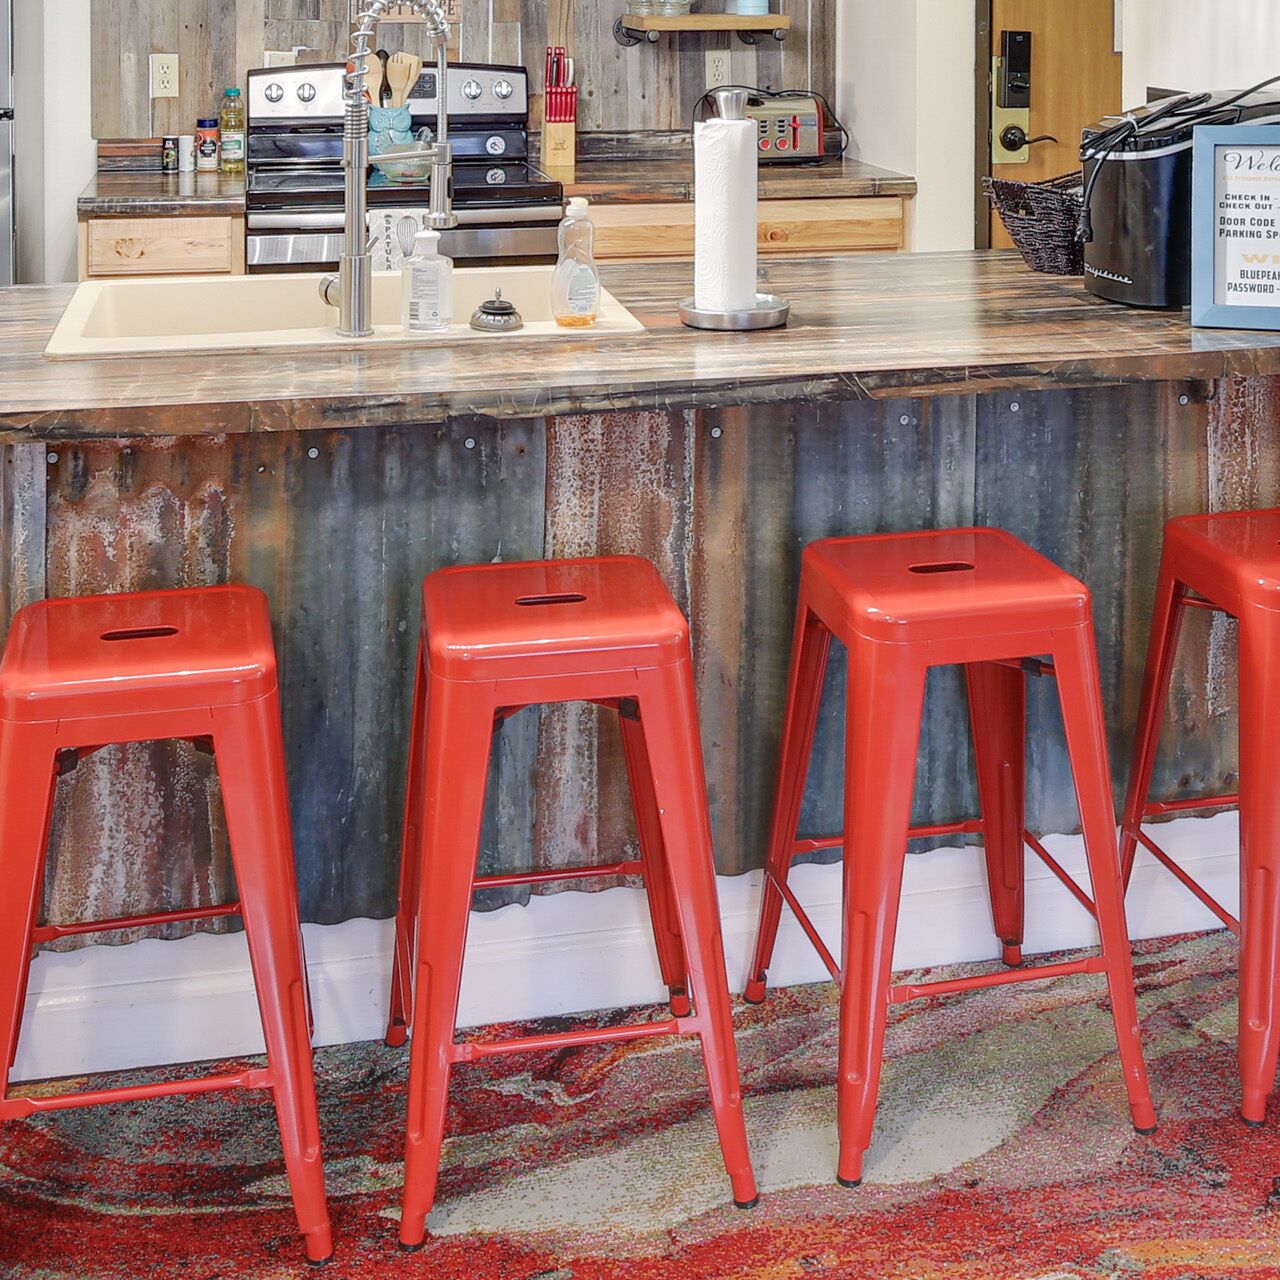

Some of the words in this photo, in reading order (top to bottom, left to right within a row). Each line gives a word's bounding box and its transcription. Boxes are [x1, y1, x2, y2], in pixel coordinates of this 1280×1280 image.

[1220, 217, 1246, 226] DOOR
[1250, 218, 1275, 227] CODE
[1219, 229, 1262, 238] PARKING
[1227, 283, 1274, 293] PASSWORD
